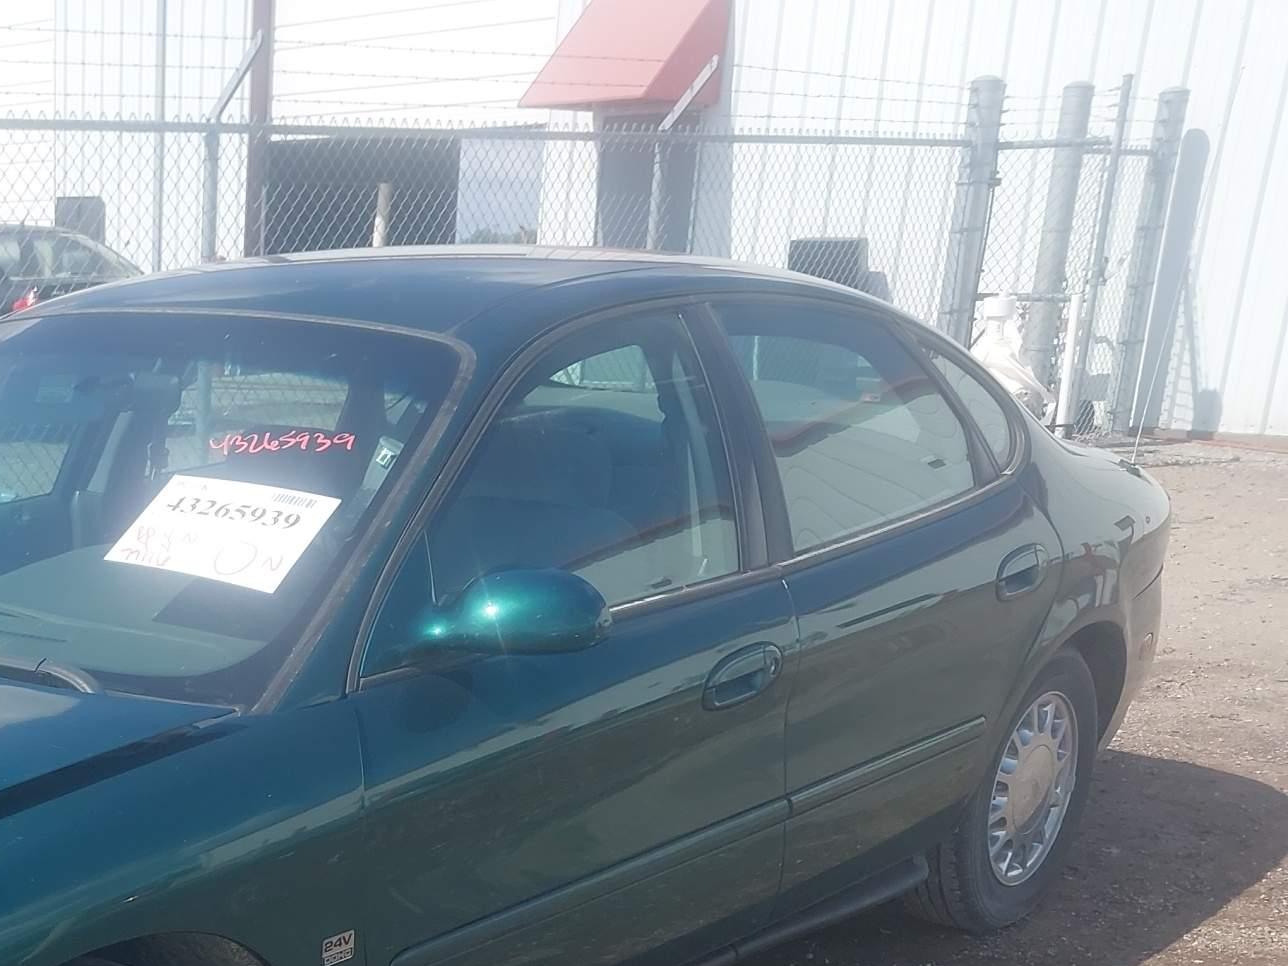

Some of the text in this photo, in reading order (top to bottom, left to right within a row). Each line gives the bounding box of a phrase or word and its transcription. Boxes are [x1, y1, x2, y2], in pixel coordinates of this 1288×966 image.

[209, 430, 357, 455] 43265939
[167, 496, 302, 529] 43265939
[324, 933, 353, 952] 24V
